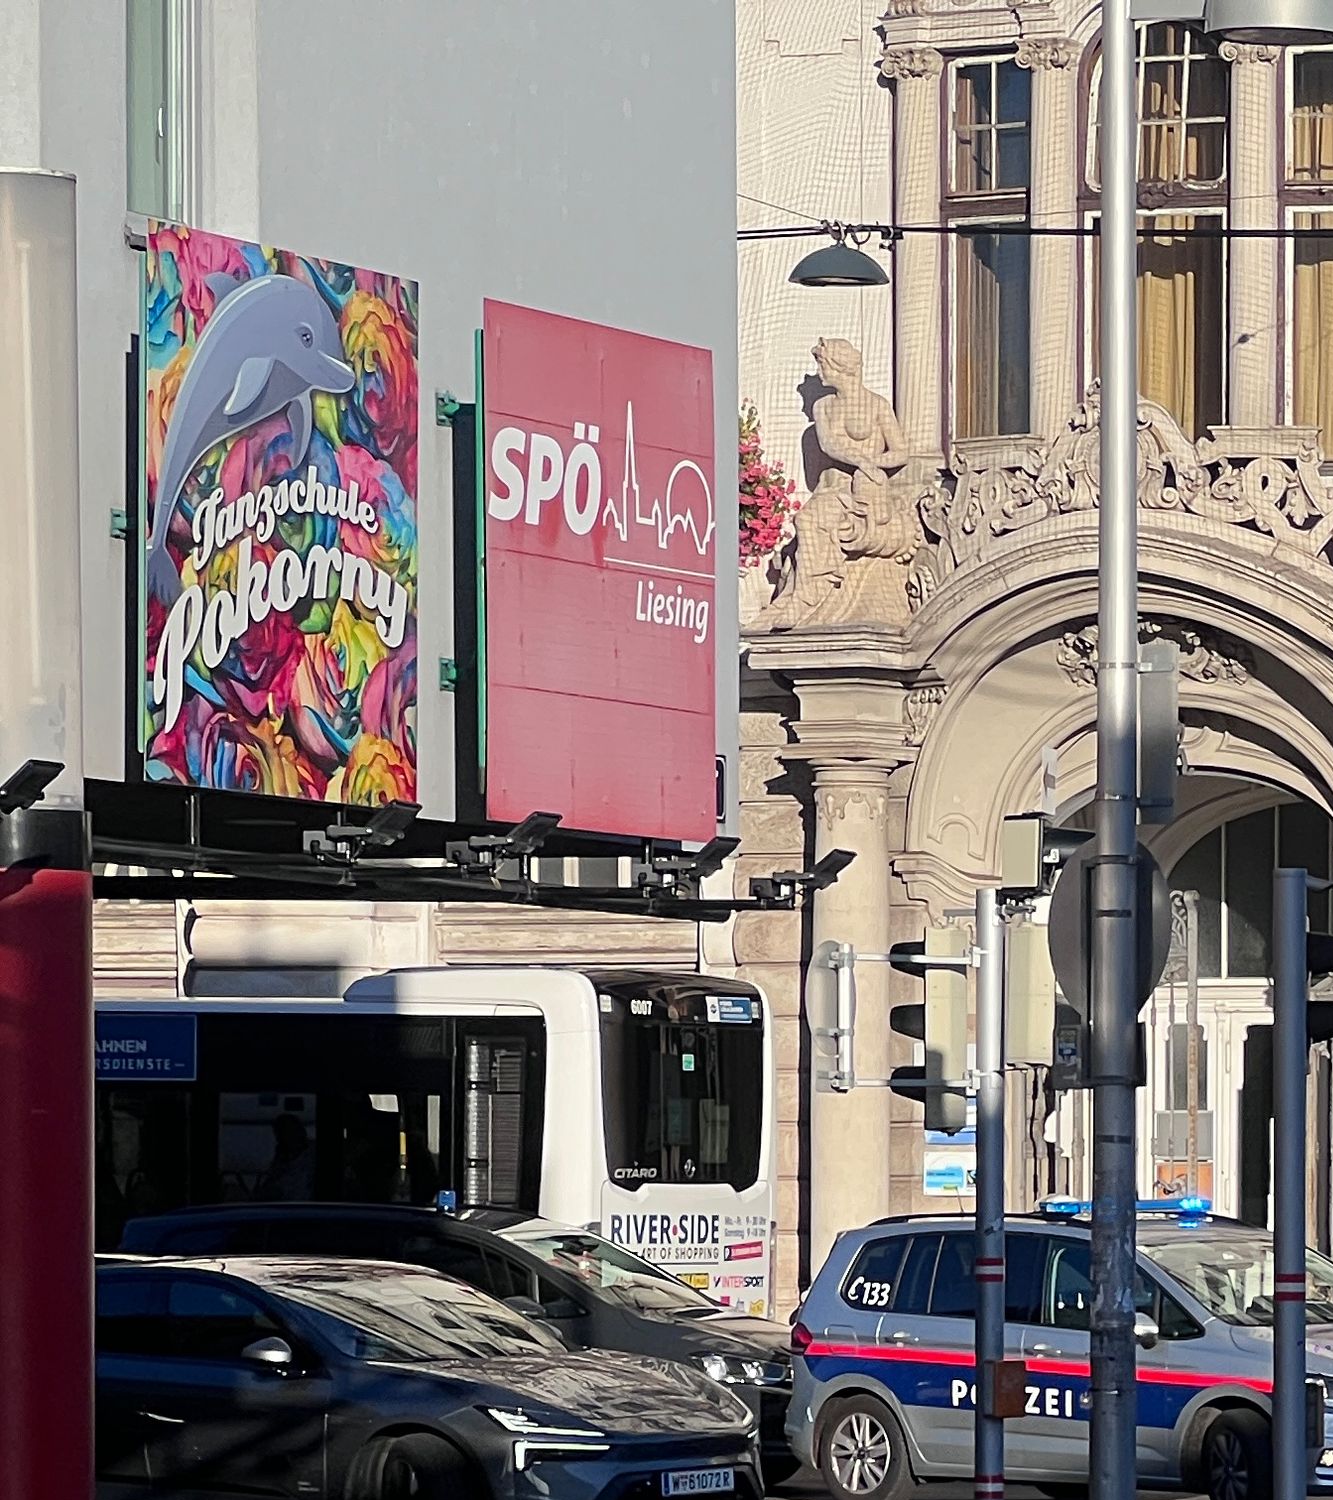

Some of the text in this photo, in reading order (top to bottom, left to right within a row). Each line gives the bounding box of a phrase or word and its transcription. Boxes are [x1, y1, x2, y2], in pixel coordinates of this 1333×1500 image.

[487, 422, 602, 536] SPÖ
[190, 465, 380, 571] Tanzschule
[152, 538, 409, 732] Pokorny
[635, 580, 710, 644] Liesing
[614, 1168, 658, 1179] CITARO
[661, 1247, 673, 1260] OF
[675, 1247, 720, 1261] SHOPPING
[862, 1281, 891, 1307] 133
[951, 1379, 1073, 1418] PZEI
